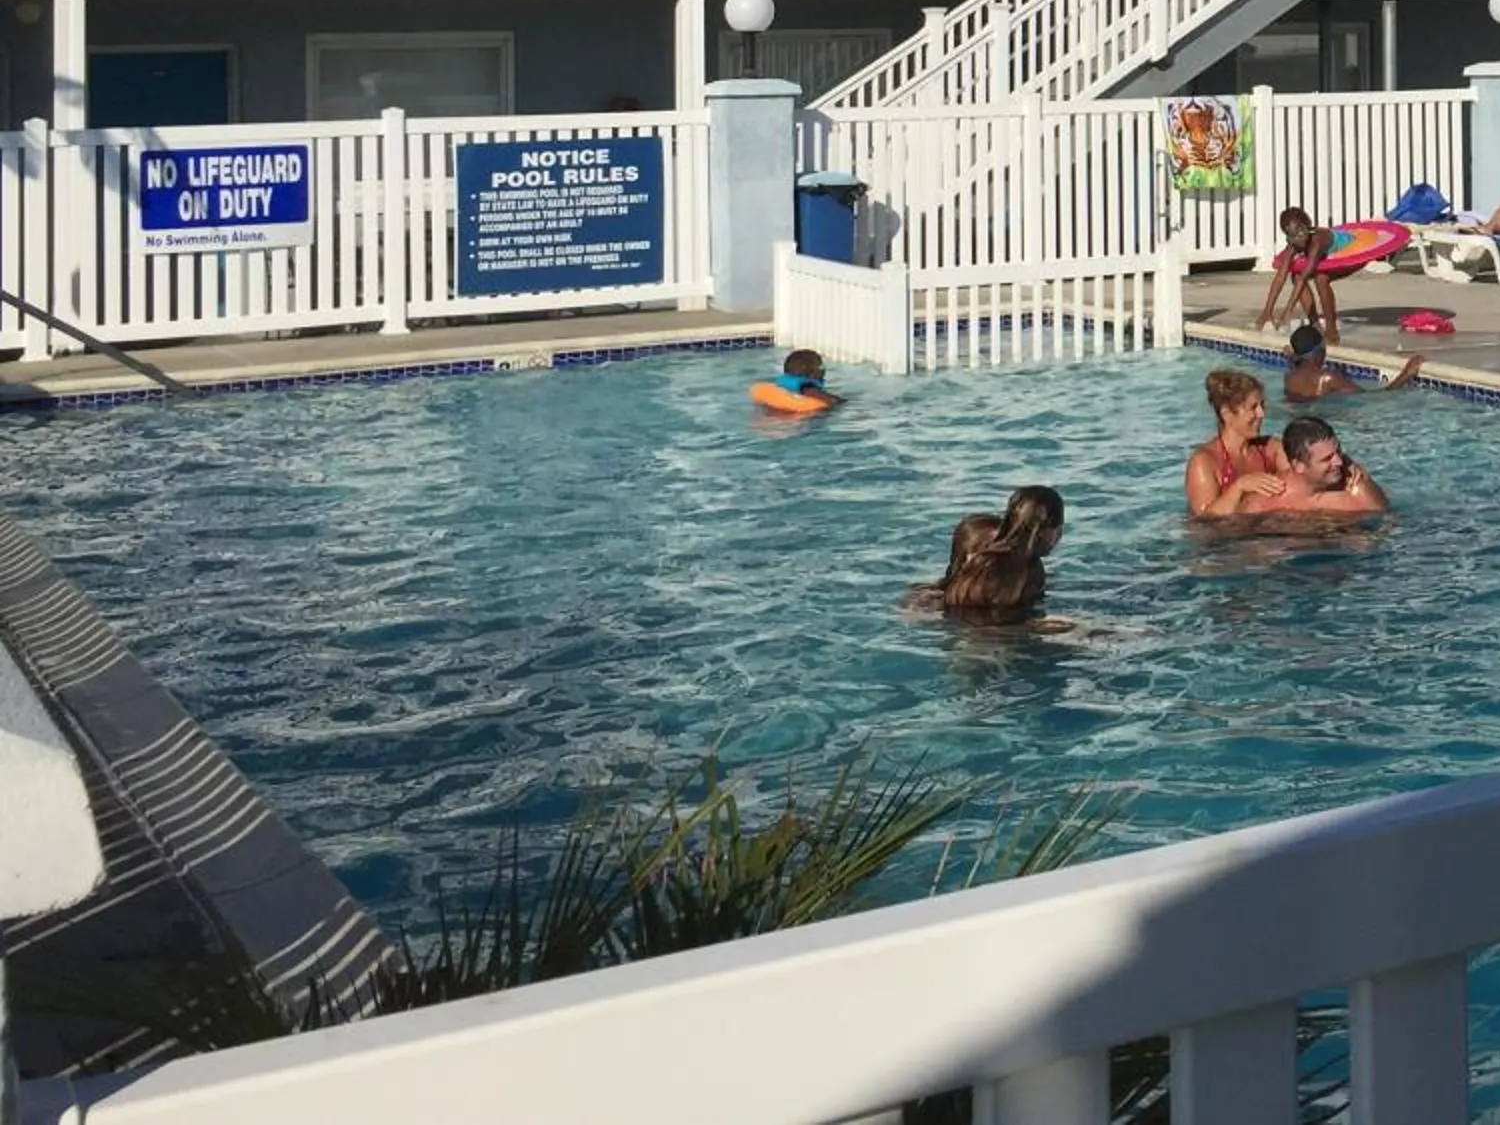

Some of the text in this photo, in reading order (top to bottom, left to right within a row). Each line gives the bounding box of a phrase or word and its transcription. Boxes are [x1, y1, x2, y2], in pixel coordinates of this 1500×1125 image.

[521, 148, 611, 168] NOTICE
[147, 153, 302, 189] NO LIFEGUARD
[491, 166, 639, 188] POOL RULES
[178, 187, 273, 221] ON DUTY
[145, 235, 163, 247] No
[166, 232, 229, 246] Swimming
